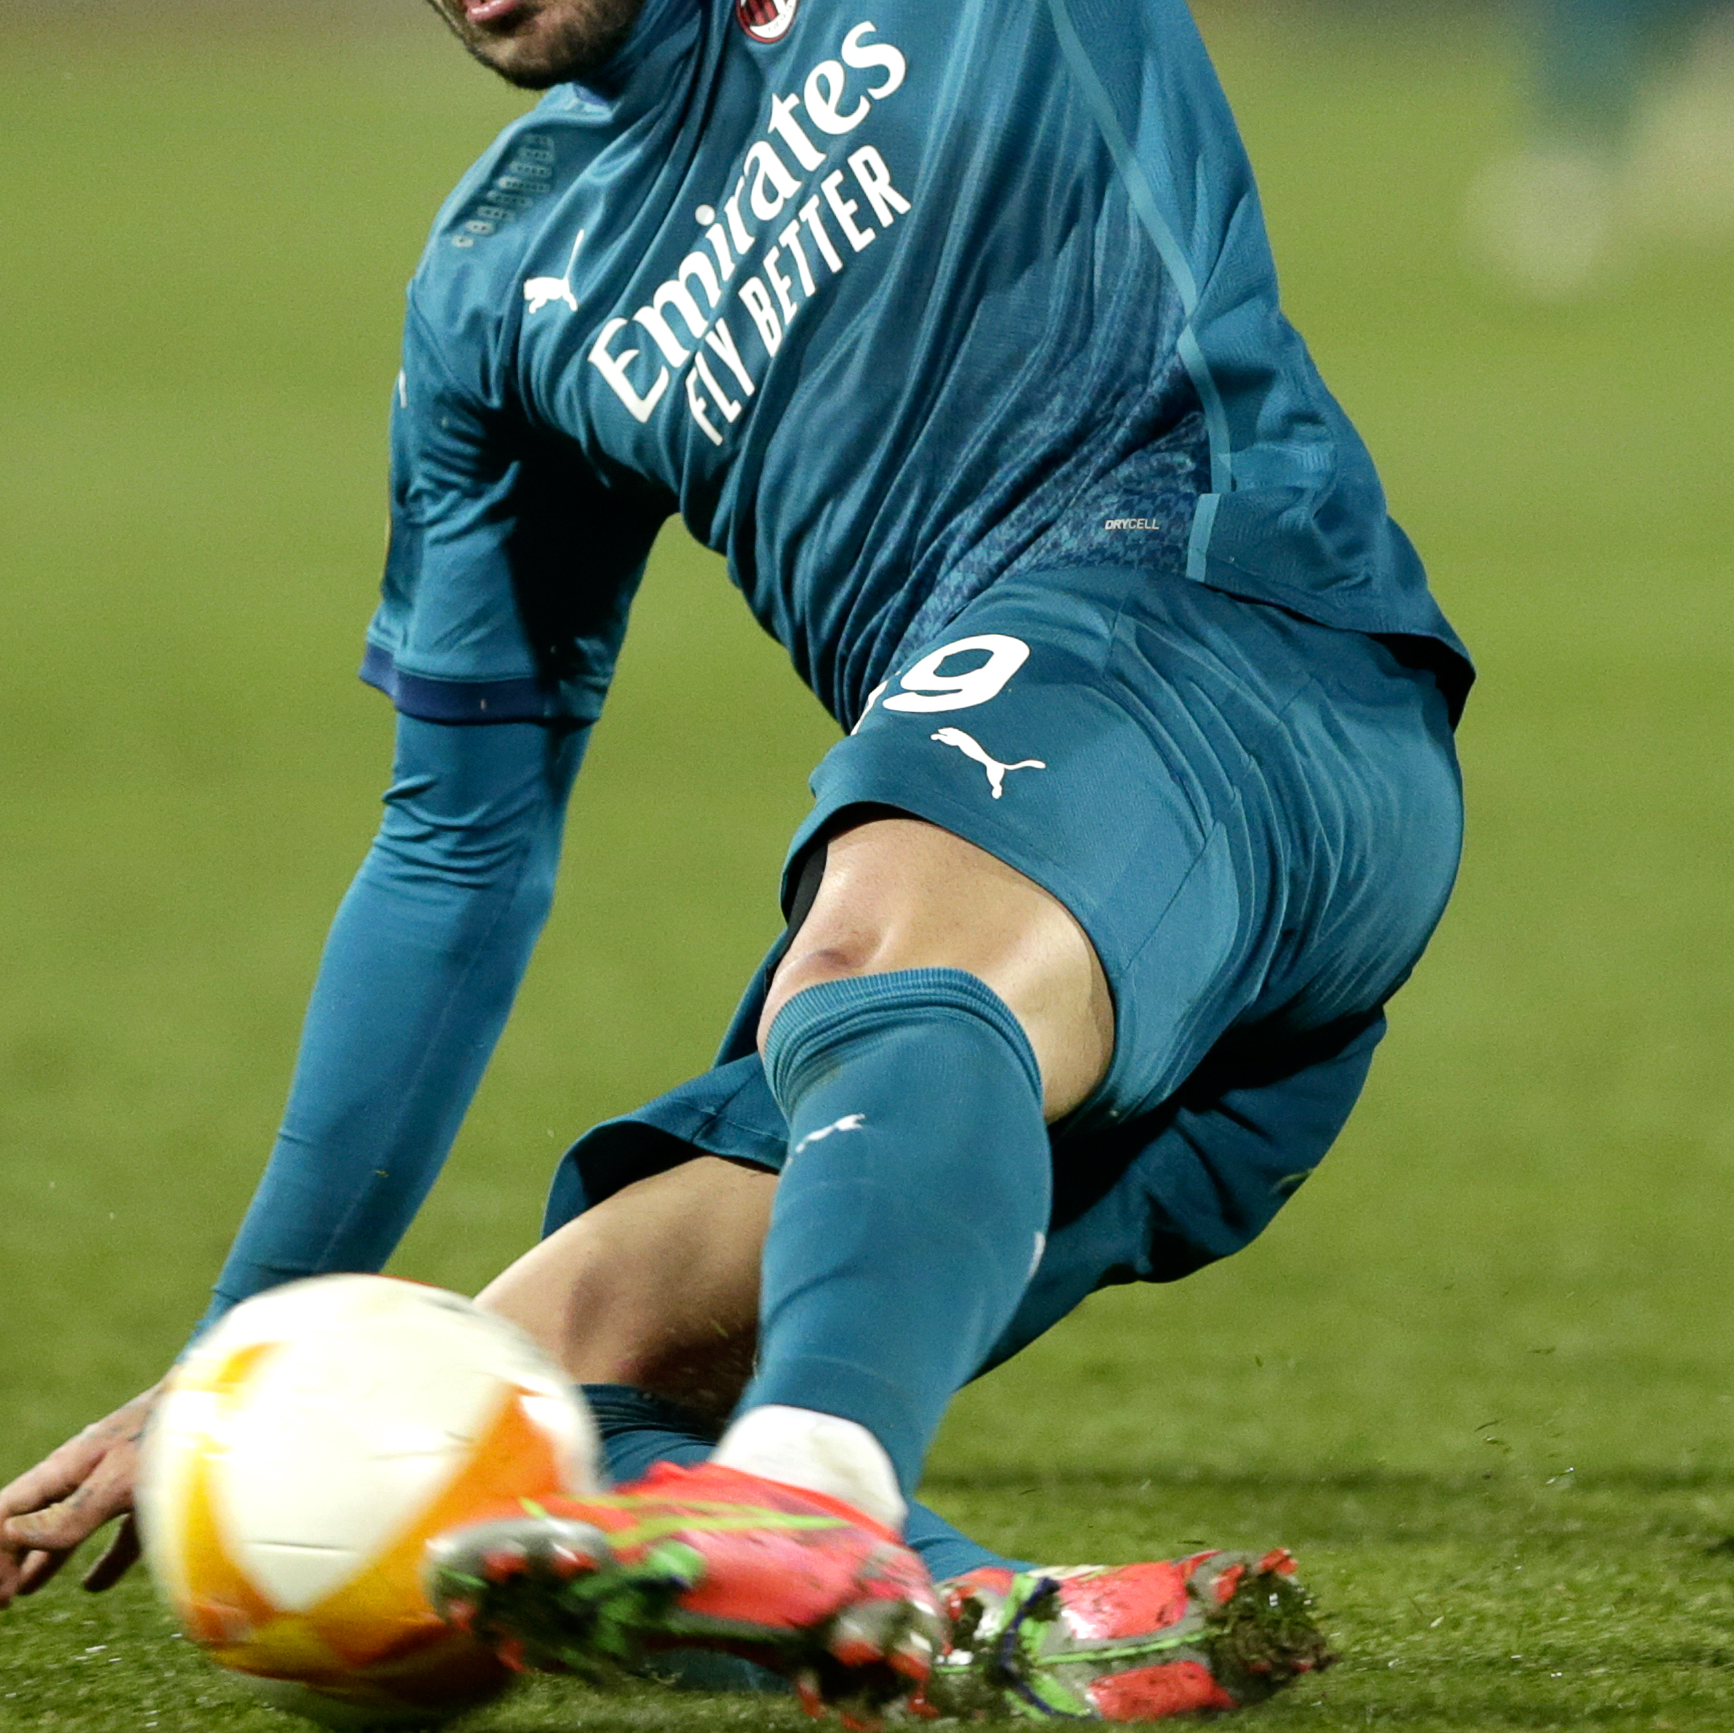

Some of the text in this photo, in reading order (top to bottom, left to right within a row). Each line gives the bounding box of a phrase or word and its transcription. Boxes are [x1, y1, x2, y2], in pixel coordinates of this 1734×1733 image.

[587, 20, 907, 424] Emirates
[685, 144, 912, 447] FLY BETTER
[1104, 517, 1161, 531] DRYCELL
